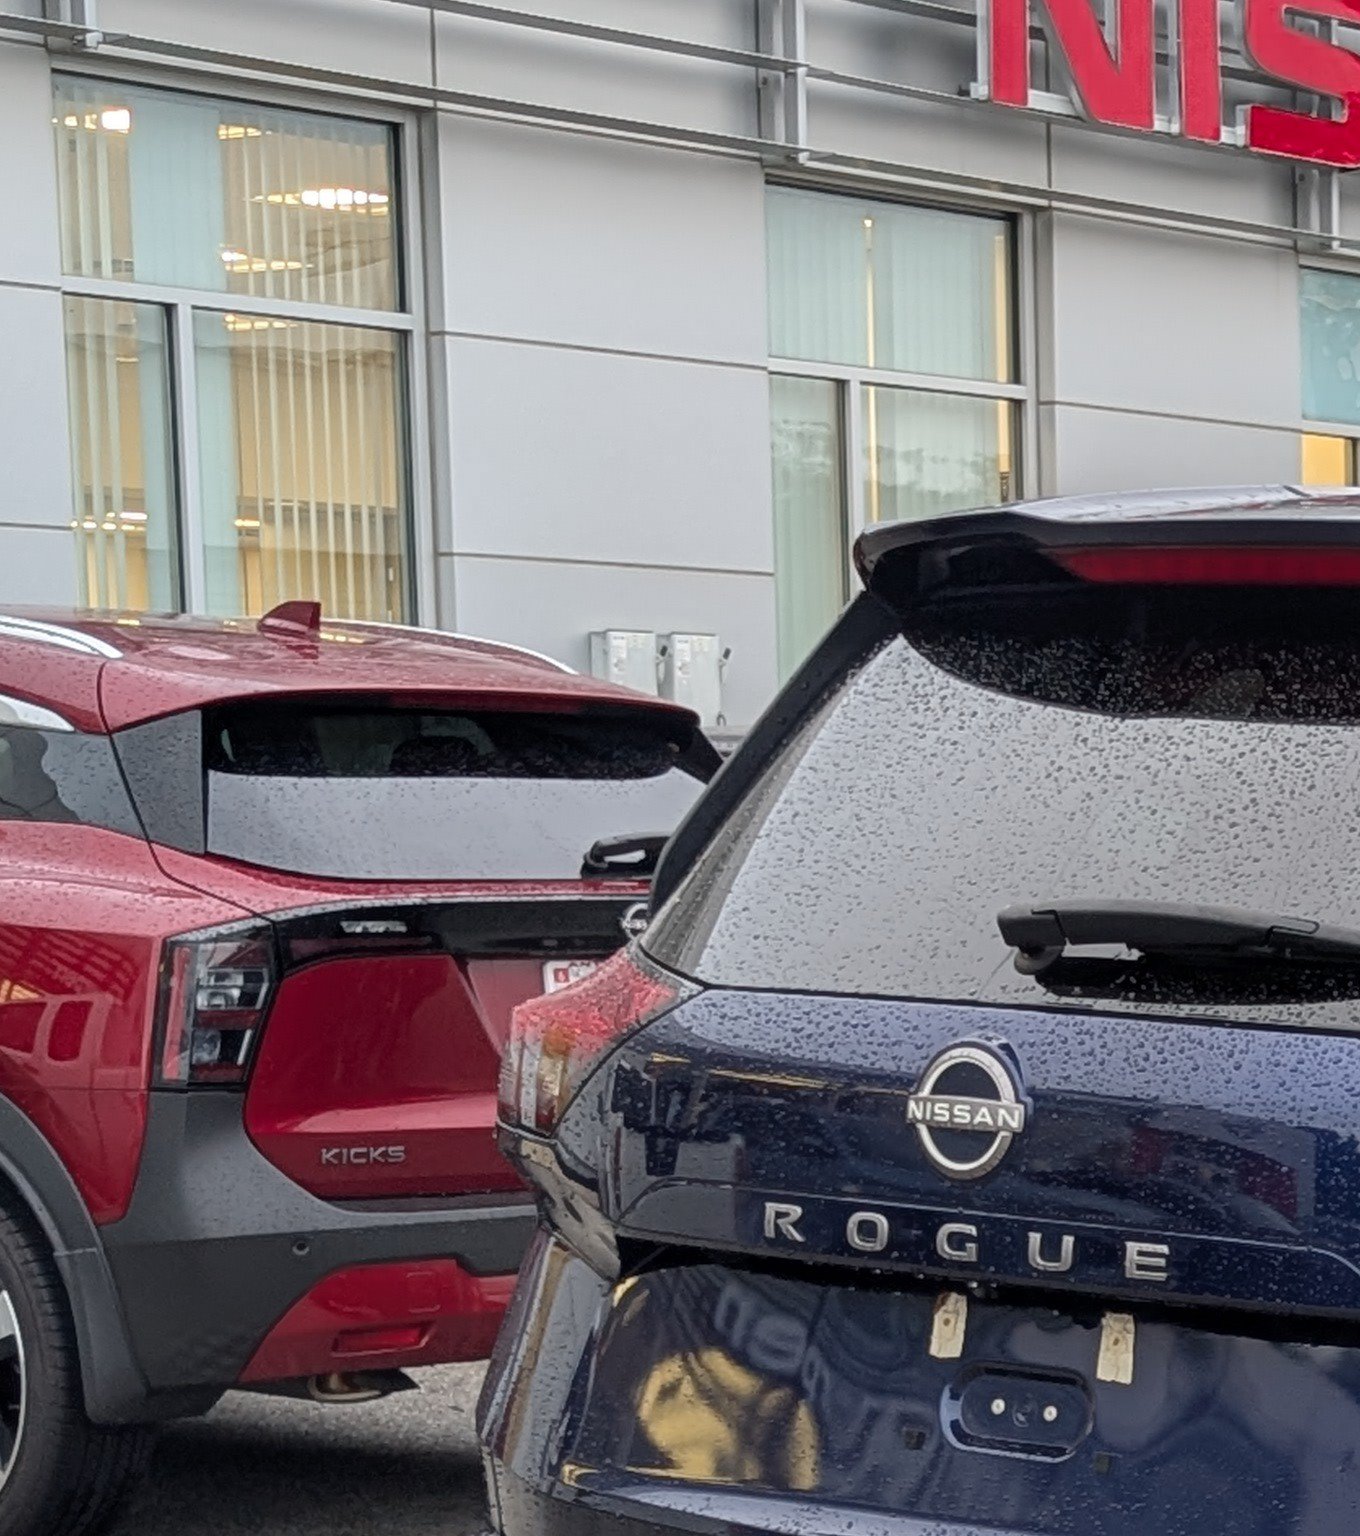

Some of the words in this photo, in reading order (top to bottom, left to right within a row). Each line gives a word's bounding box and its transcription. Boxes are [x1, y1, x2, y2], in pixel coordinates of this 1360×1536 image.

[906, 1099, 1021, 1129] NISSAN
[321, 1145, 406, 1164] KICKS
[763, 1201, 1170, 1282] ROGUE
